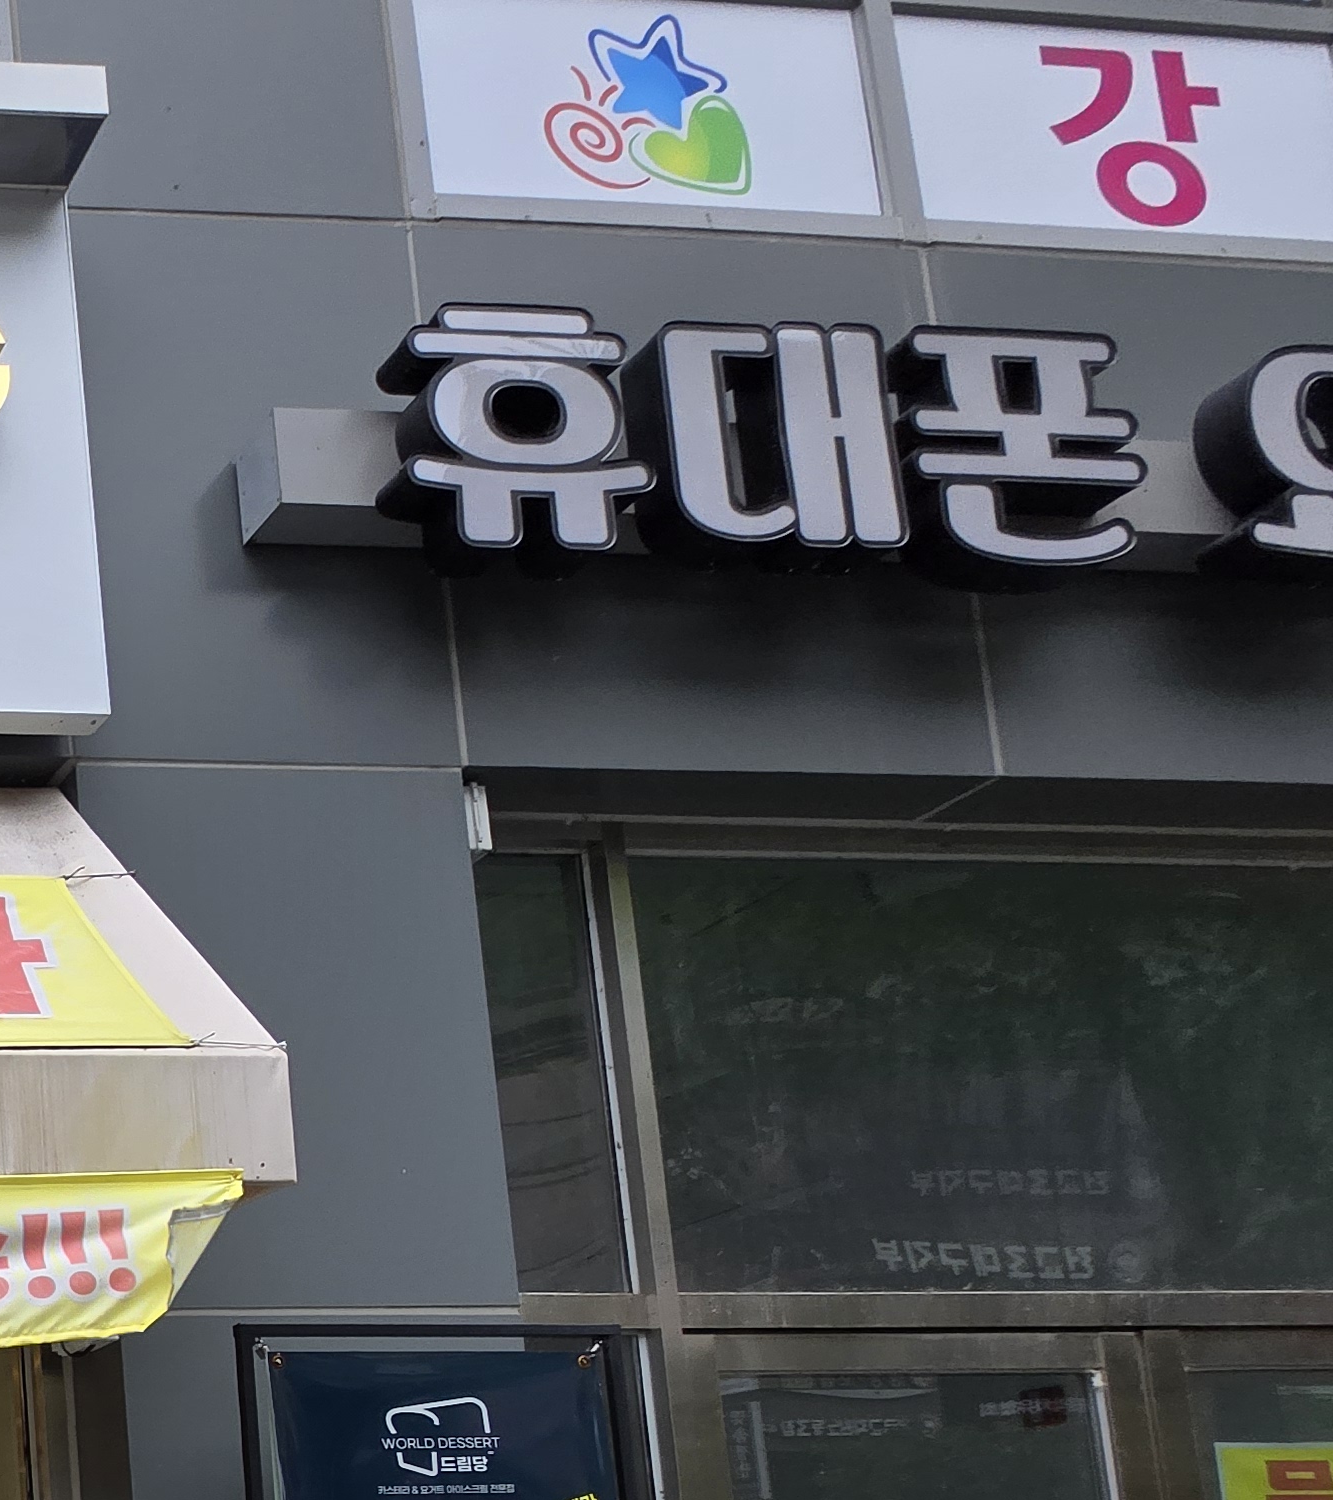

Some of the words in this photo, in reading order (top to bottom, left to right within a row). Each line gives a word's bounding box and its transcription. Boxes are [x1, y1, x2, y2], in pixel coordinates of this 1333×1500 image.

[1038, 45, 1220, 226] 강
[403, 303, 1146, 566] 휴대폰
[381, 1438, 435, 1449] WORLD
[438, 1437, 501, 1449] DESSERT
[440, 1456, 488, 1472] 드림당
